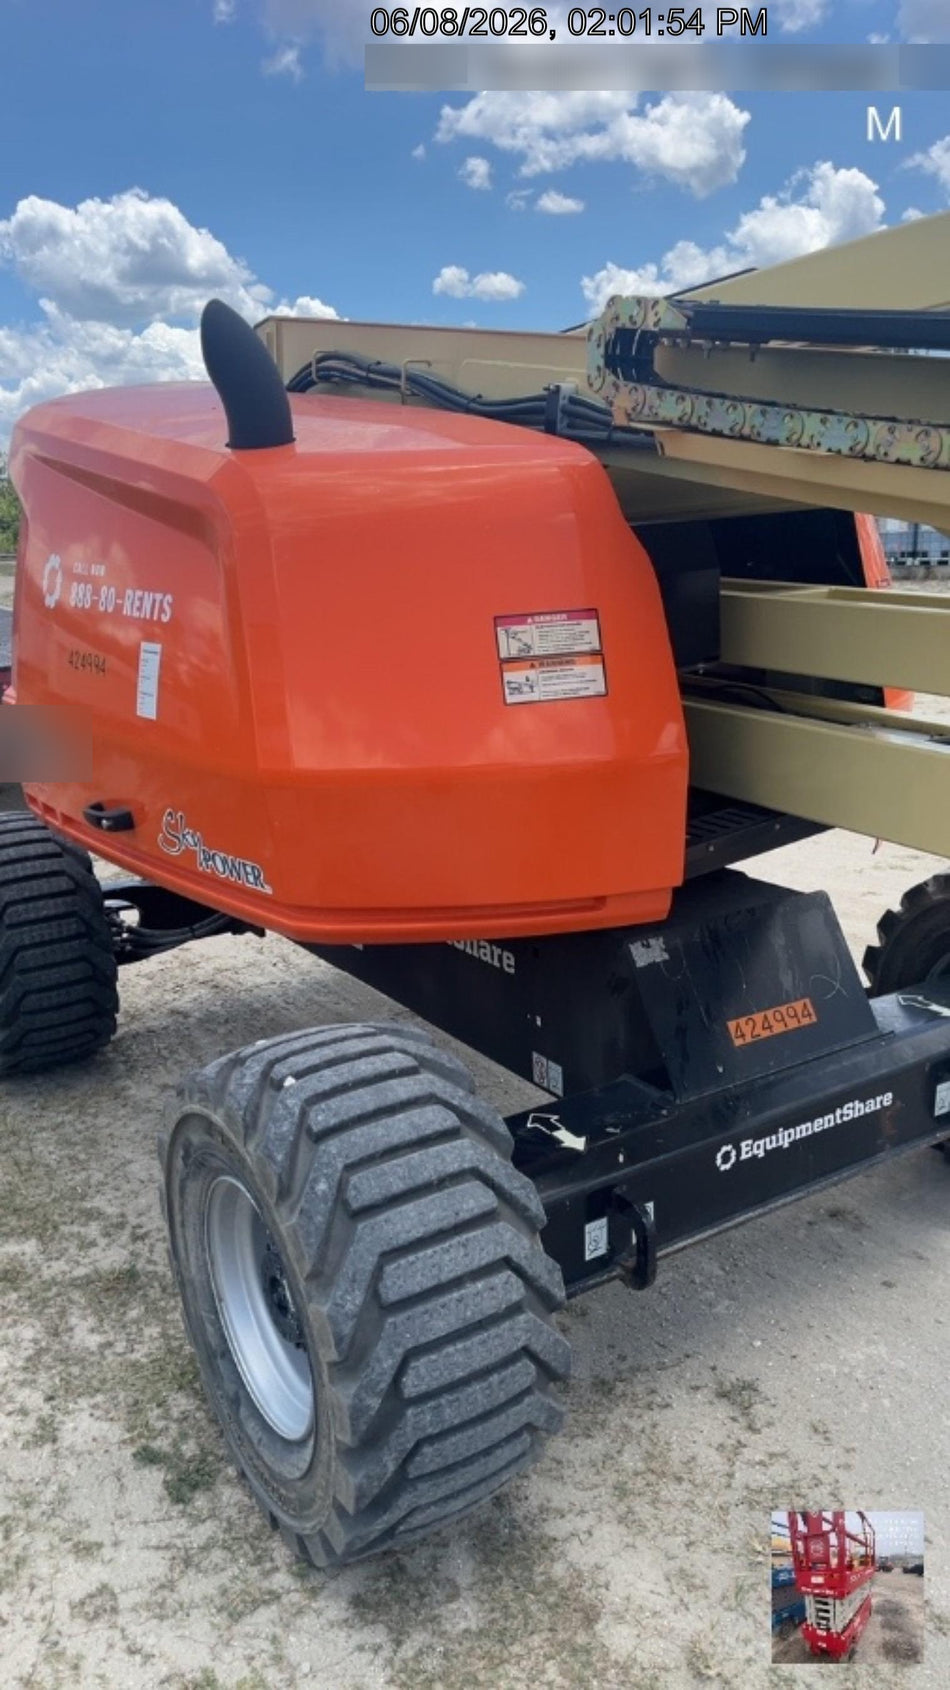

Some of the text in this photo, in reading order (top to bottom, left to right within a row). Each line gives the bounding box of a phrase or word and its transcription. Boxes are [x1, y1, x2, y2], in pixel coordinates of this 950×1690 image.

[71, 582, 173, 622] 888-80-RENTS
[734, 1001, 814, 1043] 424994
[738, 1092, 894, 1161] EquipmentShare
